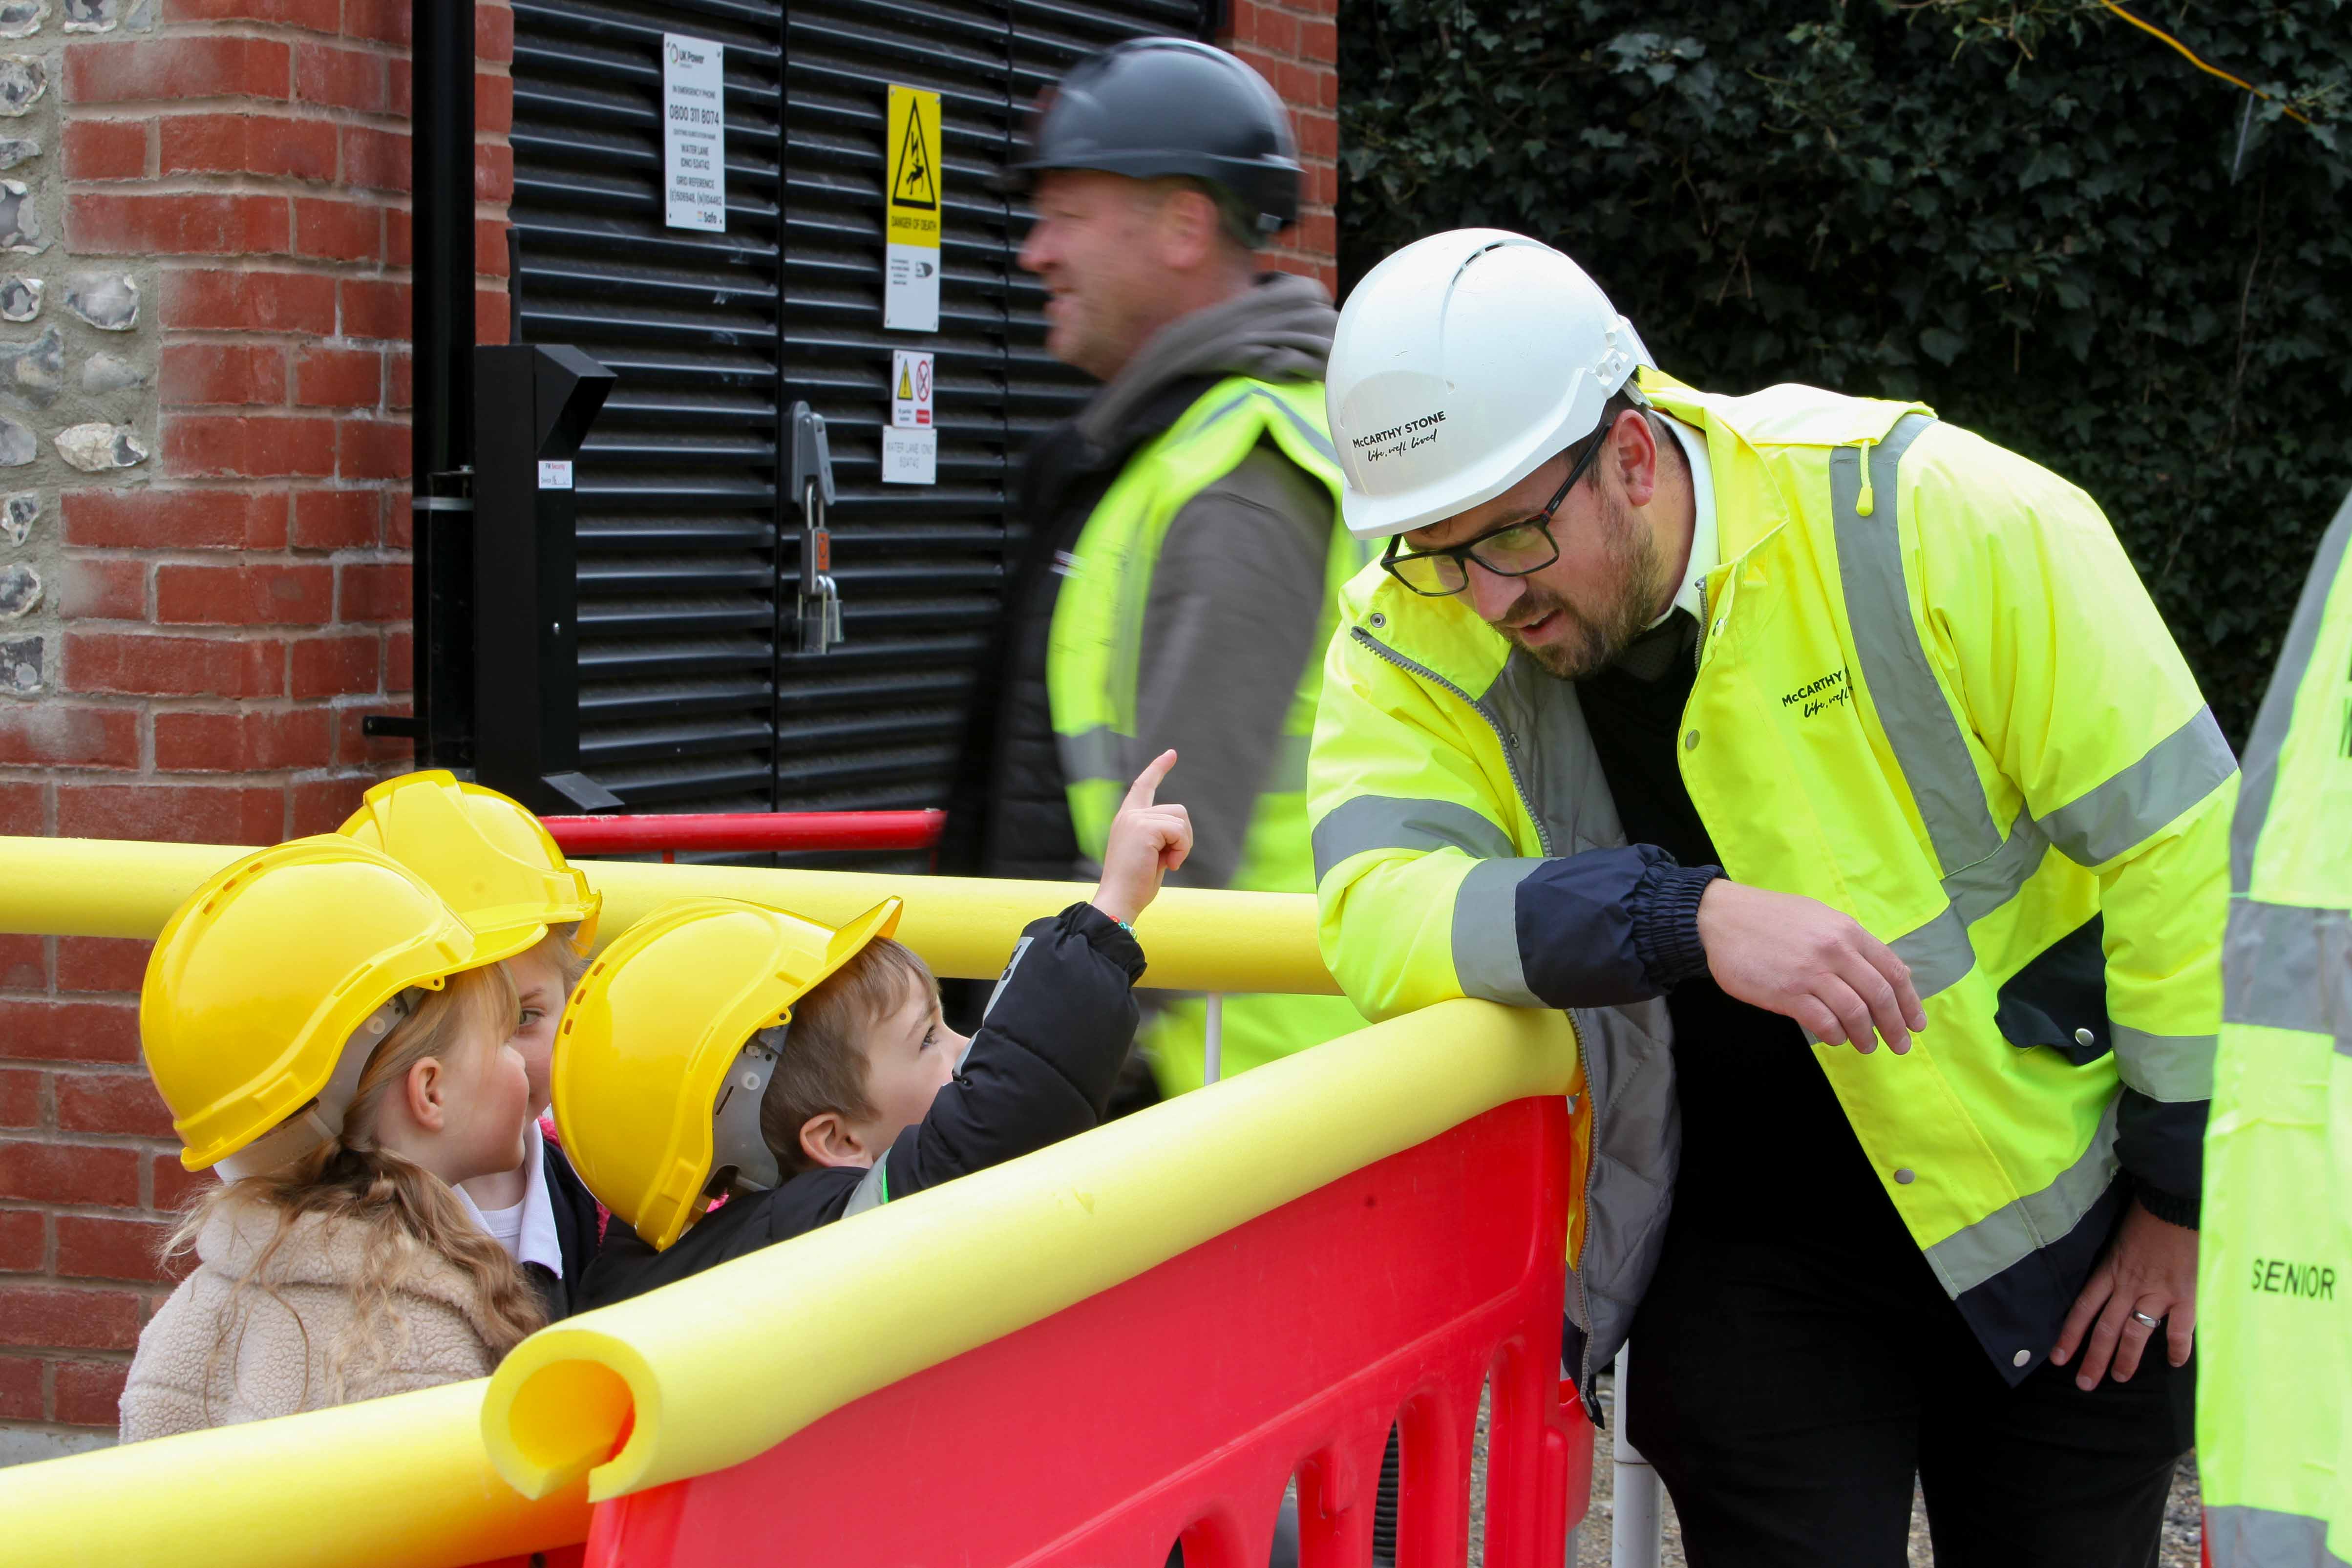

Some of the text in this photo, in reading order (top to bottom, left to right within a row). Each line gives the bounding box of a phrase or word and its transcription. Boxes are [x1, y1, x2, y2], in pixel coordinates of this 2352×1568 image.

[669, 104, 720, 125] 0800 311 8074
[891, 215, 937, 231] DANGER OF DEATH
[1353, 411, 1446, 448] McCARTHY STONE
[1782, 670, 1842, 707] McCARTHY
[2252, 1259, 2335, 1300] SENIOR
